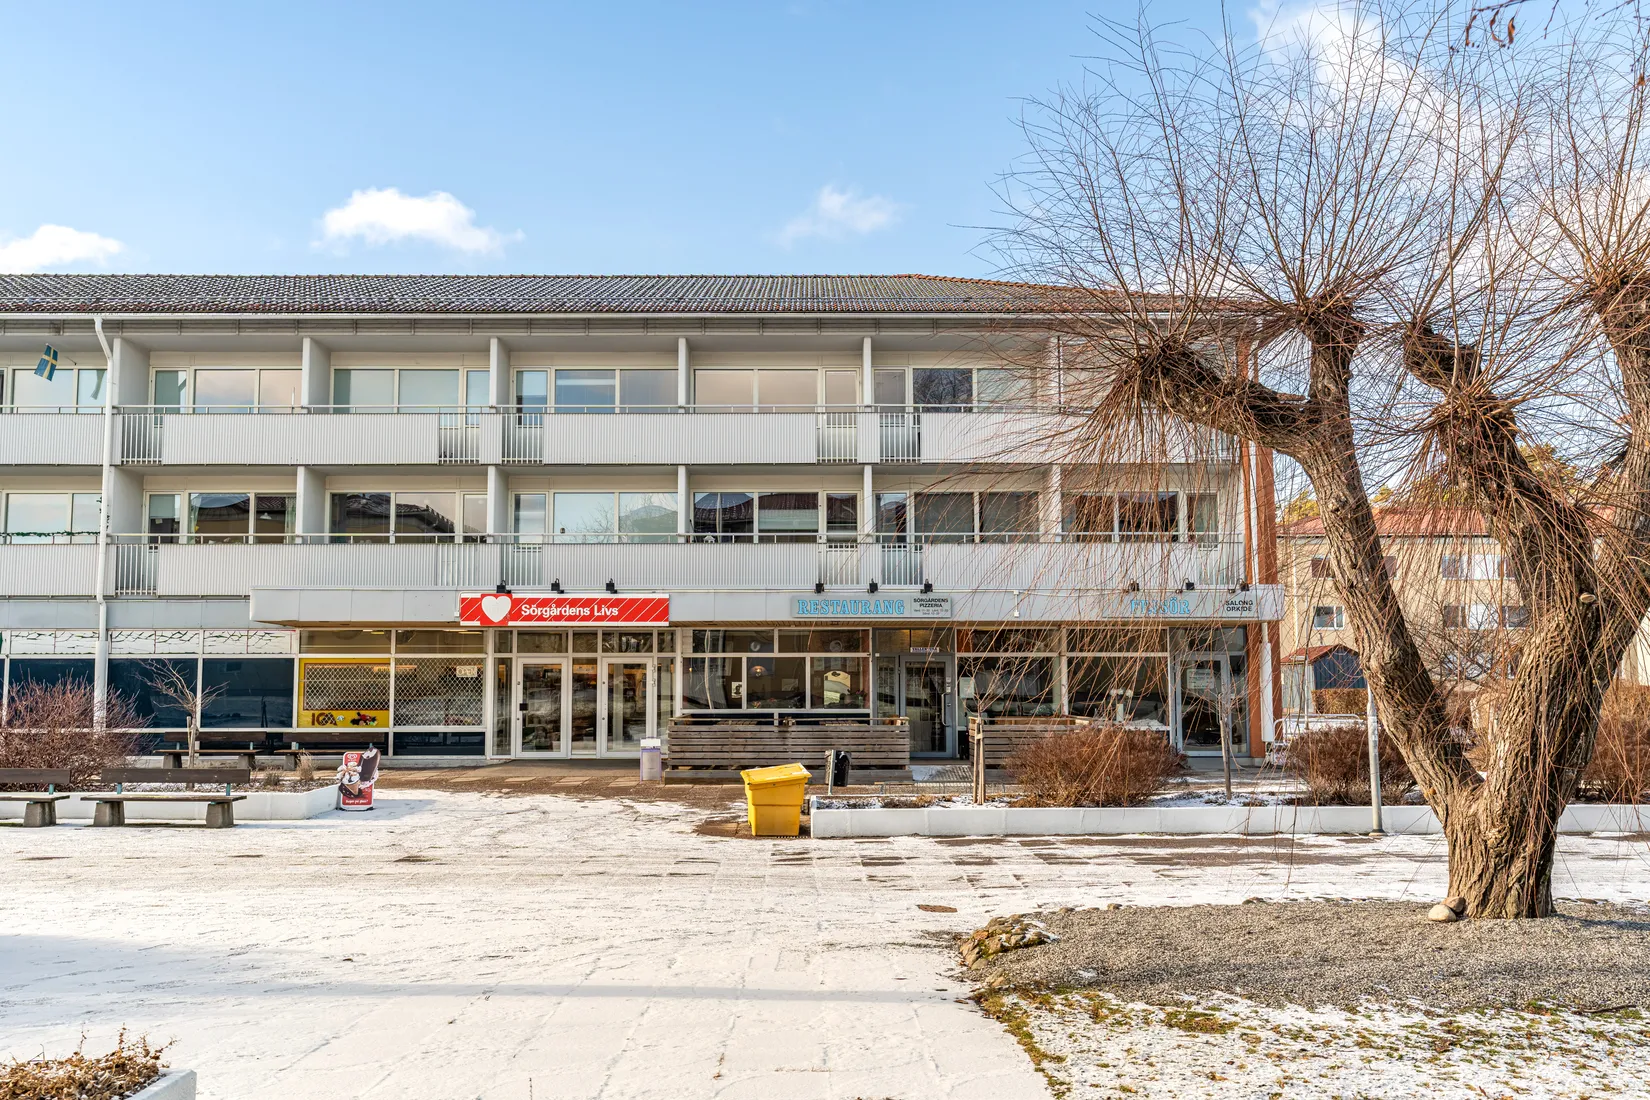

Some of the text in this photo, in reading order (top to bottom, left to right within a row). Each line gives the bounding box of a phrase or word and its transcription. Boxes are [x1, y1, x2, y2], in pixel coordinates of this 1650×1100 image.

[521, 604, 618, 618] Sörgårdens Livs
[797, 599, 905, 615] RESTAURANG
[457, 667, 476, 676] OPEN
[311, 712, 338, 727] ICA
